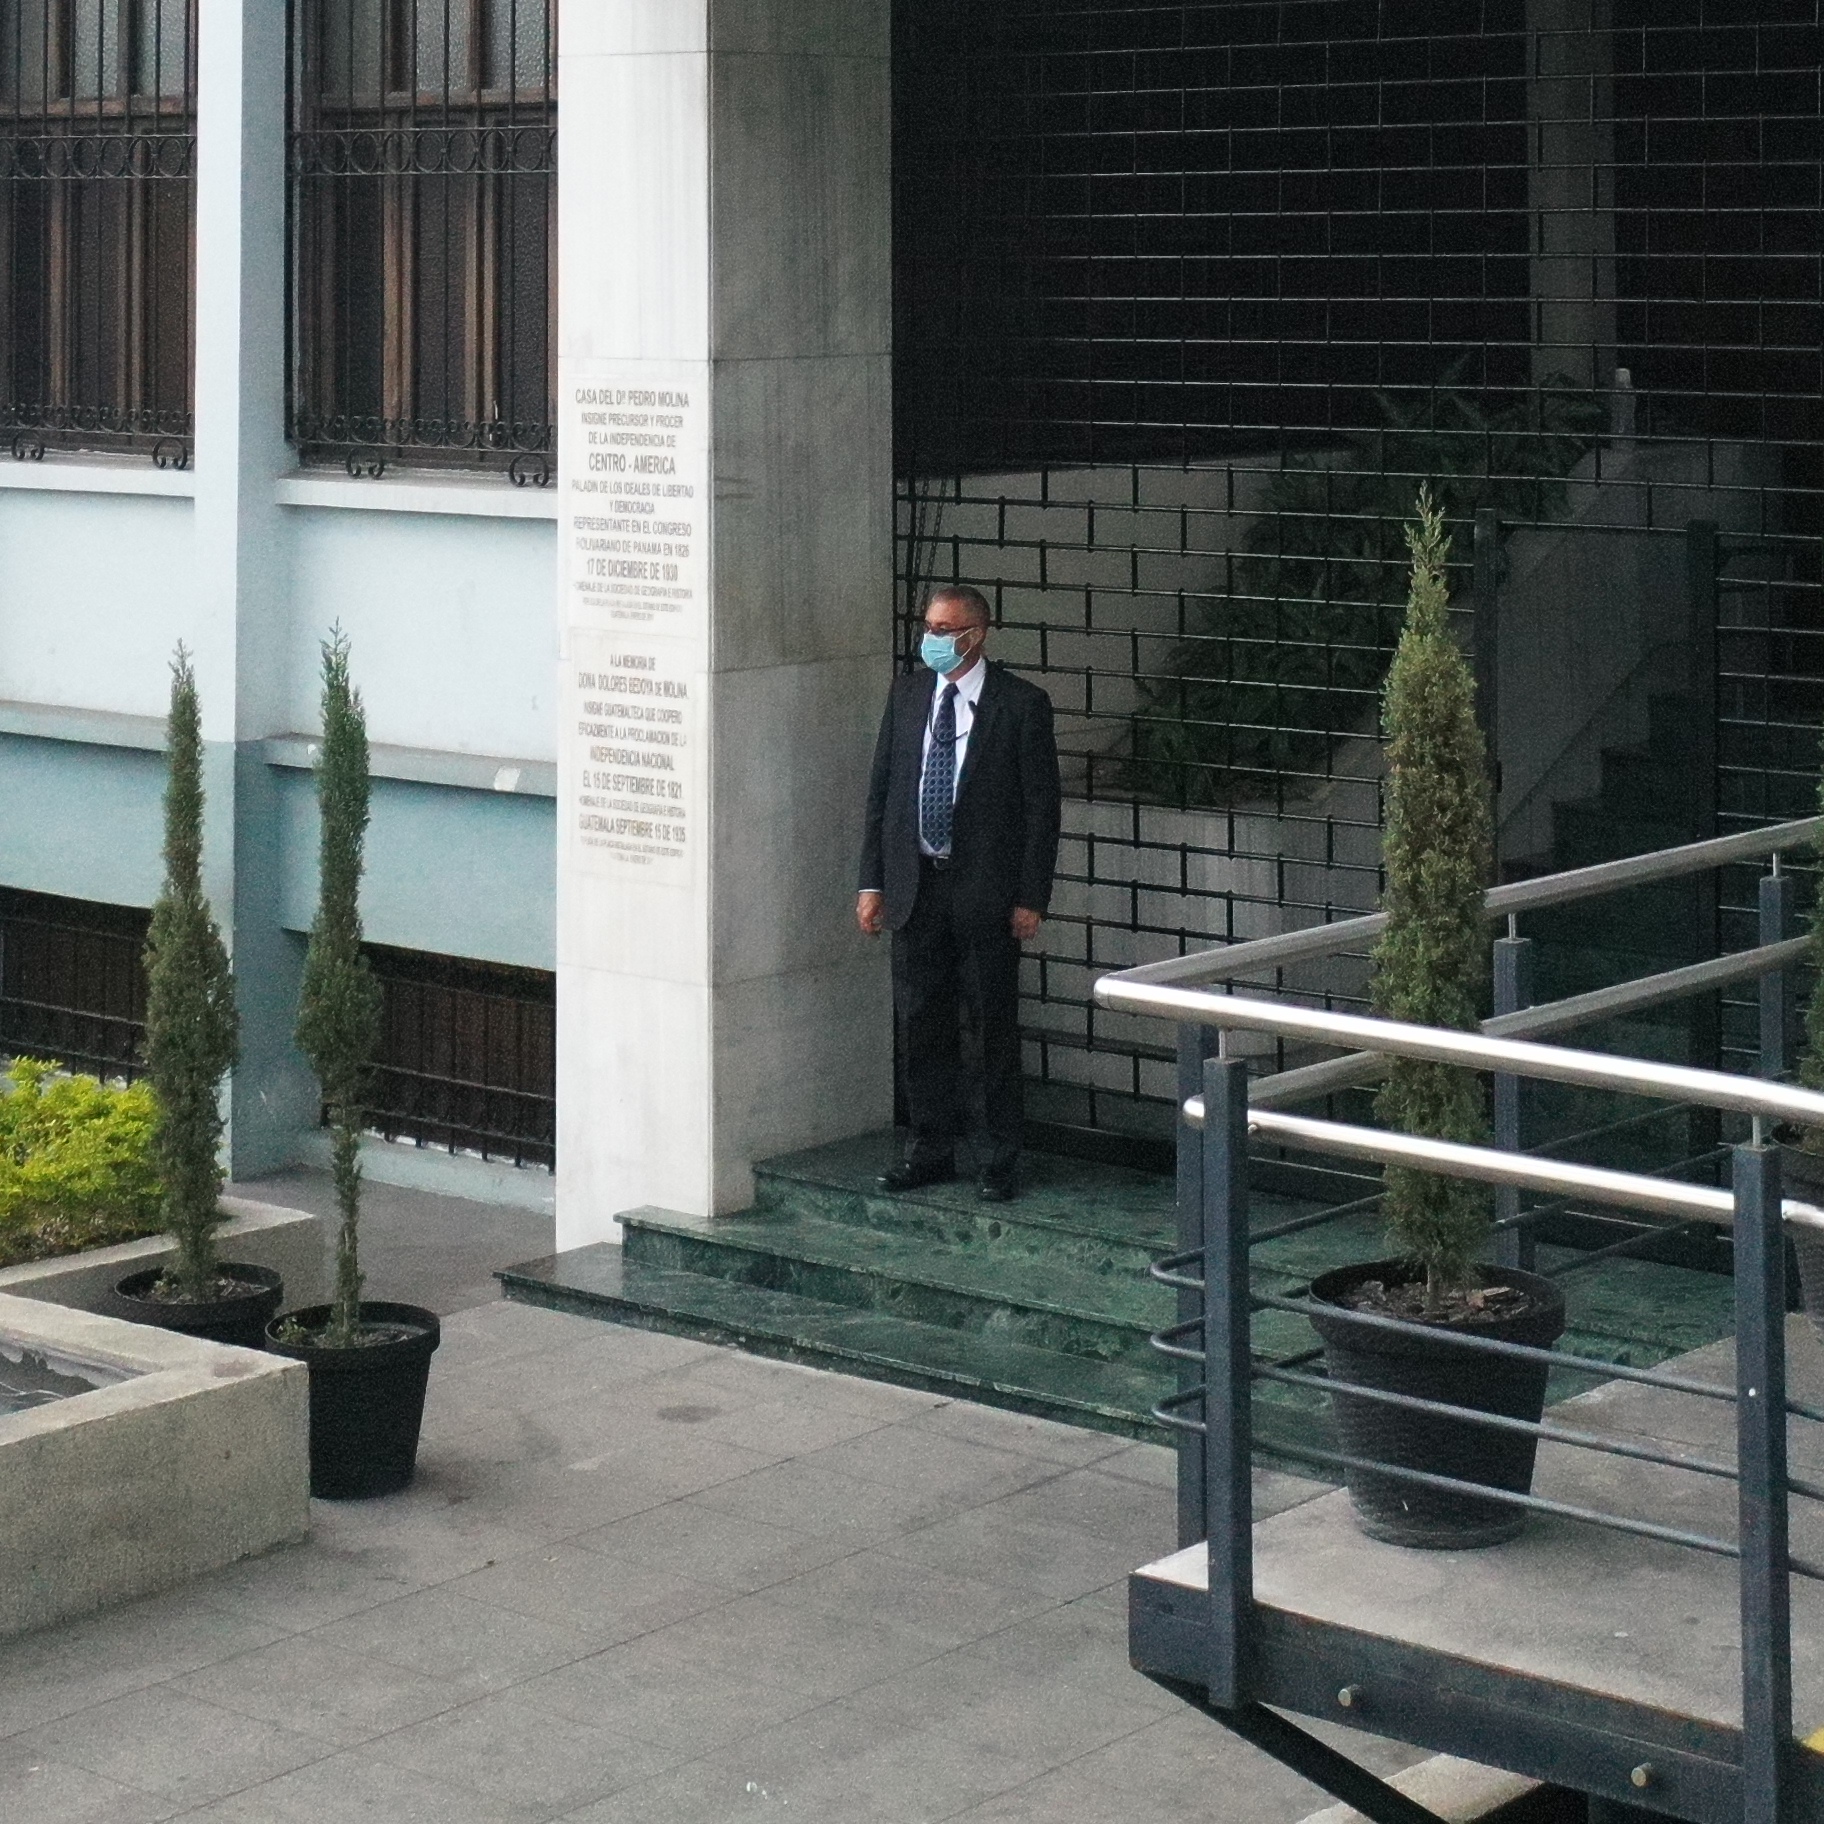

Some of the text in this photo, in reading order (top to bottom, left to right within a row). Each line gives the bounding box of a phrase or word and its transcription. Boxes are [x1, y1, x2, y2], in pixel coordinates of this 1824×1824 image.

[575, 388, 598, 405] CASA
[598, 388, 614, 405] DEL
[628, 390, 656, 406] PEDRO
[657, 391, 690, 408] MOLINA
[581, 412, 607, 425] INSIGNE
[608, 412, 648, 427] PRECURSOR
[588, 431, 676, 448] DE LA INDEPENDENCIA DE
[588, 452, 626, 473] CENTRO
[633, 454, 676, 475] AMERICA
[599, 479, 608, 494] DE
[609, 480, 622, 495] LOS
[623, 481, 651, 496] IDEALES
[651, 483, 661, 497] DE
[614, 500, 655, 515] DEMOCRACIA
[573, 516, 692, 537] REPRESENTANTE EN EL CONGRESO
[621, 539, 631, 554] DE
[662, 542, 673, 557] EN
[587, 558, 595, 576] 17
[596, 559, 607, 577] DE
[607, 559, 648, 580] DICIEMBRE
[649, 561, 660, 581] DE
[598, 673, 627, 693] DOLORES
[590, 744, 640, 766] INDEPENDENCIA
[582, 769, 591, 788] EL
[601, 772, 611, 791] DE
[612, 773, 654, 796] SEPTIEMBRE
[656, 778, 666, 797] DE
[615, 817, 653, 839] SEPTIEMBRE
[662, 824, 670, 841] DE
